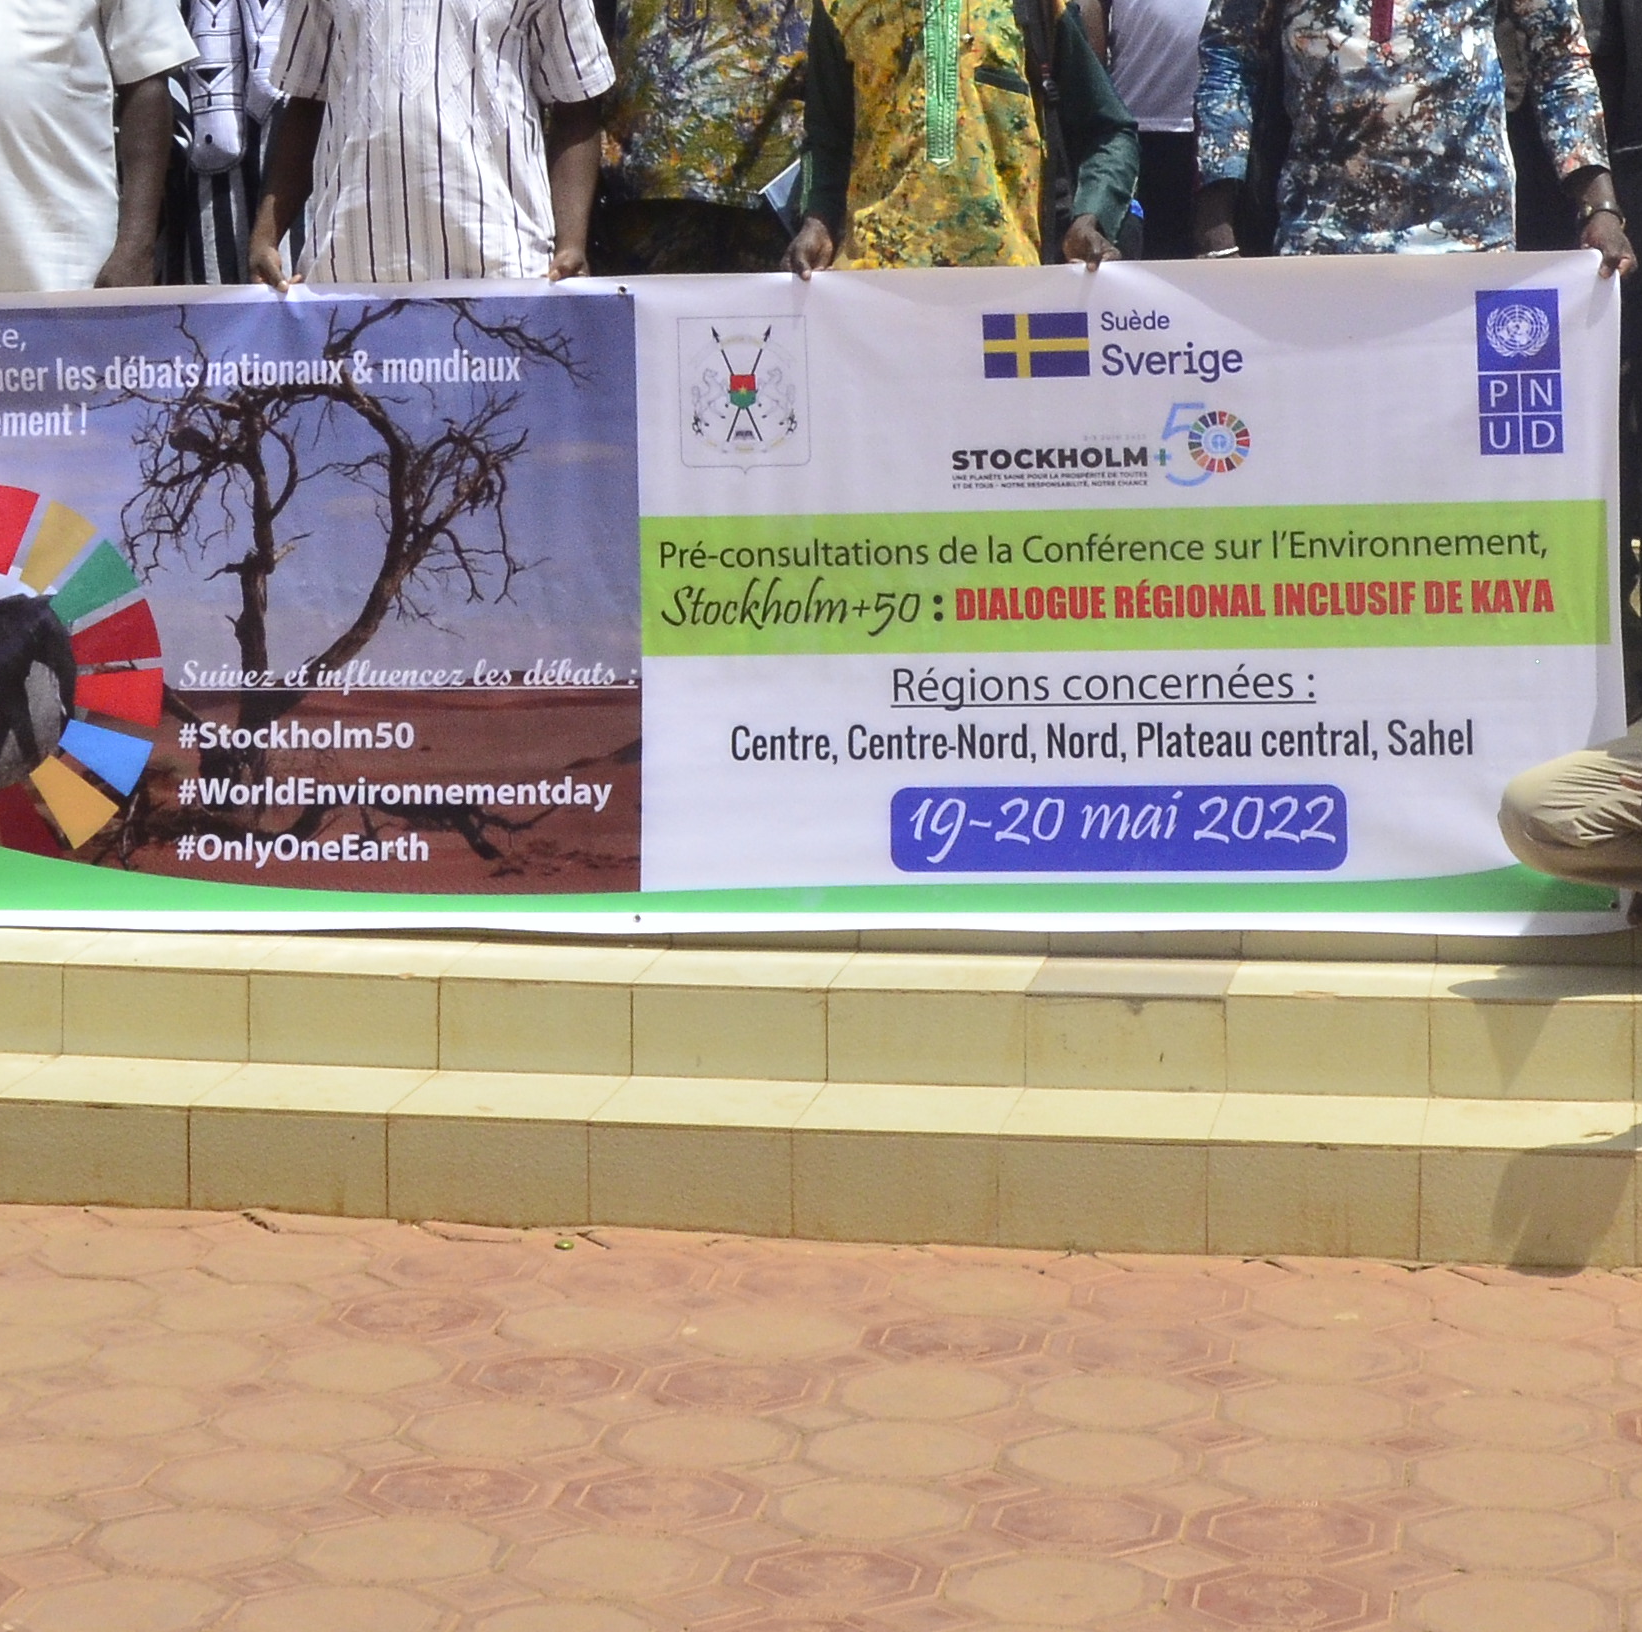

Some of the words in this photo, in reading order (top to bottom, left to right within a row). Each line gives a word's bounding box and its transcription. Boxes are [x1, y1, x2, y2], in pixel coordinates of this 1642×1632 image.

[1100, 310, 1170, 331] Suède
[56, 357, 97, 391] les
[105, 355, 199, 390] débats
[207, 353, 343, 388] nationaux
[351, 350, 373, 384] &
[382, 348, 520, 384] mondiaux
[1102, 342, 1243, 383] Sverige
[951, 446, 1148, 471] STOCKHOLM
[660, 538, 930, 569] Pré-consultations
[938, 536, 978, 564] de
[988, 535, 1013, 564] la
[1022, 533, 1205, 563] Conférence
[1215, 536, 1261, 561] sur
[1272, 529, 1548, 560] l'Environnement,
[661, 575, 921, 637] Stockholm+50
[956, 586, 1105, 621] DIALOGUE
[1114, 579, 1266, 619] RÉGIONAL
[1273, 581, 1415, 617] INCLUSIF
[1425, 580, 1462, 615] DE
[1471, 578, 1554, 614] KAYA
[179, 660, 275, 688] Suivez
[284, 663, 309, 687] et
[315, 660, 466, 696] influencez
[472, 659, 514, 686] les
[522, 658, 616, 687] débats
[892, 666, 1050, 711] Régions
[1063, 664, 1293, 701] concernées
[178, 721, 415, 751] #Stockholm50
[731, 724, 839, 764] Centre,
[847, 723, 1037, 764] Centre-Nord,
[1047, 722, 1127, 763] Nord,
[1137, 721, 1251, 758] Plateau
[1261, 719, 1379, 761] central,
[1388, 718, 1475, 757] Sahel
[177, 776, 613, 812] #WorldEnvironnementday
[910, 797, 1065, 863] 19-20
[1081, 790, 1183, 841] mai
[1193, 795, 1336, 844] 2022
[176, 832, 430, 867] #OnlyOneEarth
